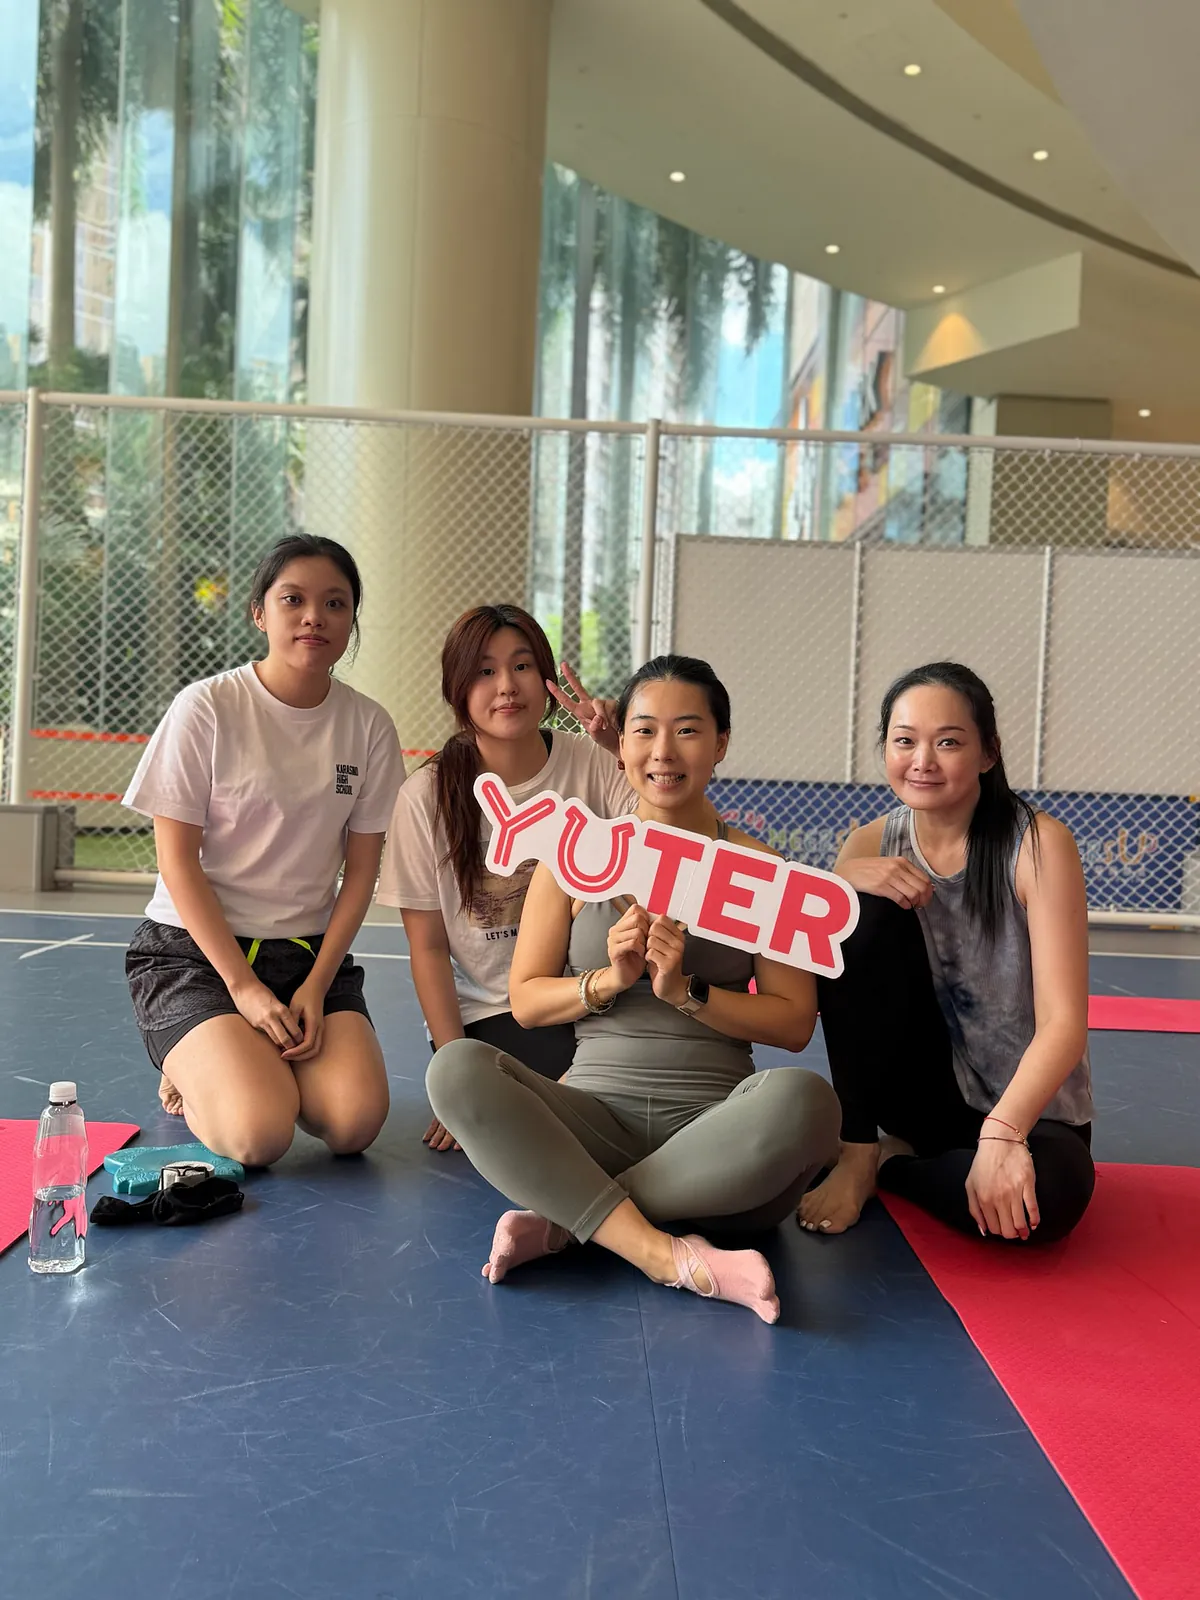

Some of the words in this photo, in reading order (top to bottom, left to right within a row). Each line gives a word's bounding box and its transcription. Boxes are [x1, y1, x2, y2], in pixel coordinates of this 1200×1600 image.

[336, 774, 348, 784] HIGH
[336, 784, 353, 796] SCHOOL
[480, 779, 852, 969] YUTER
[486, 930, 508, 940] LET'S
